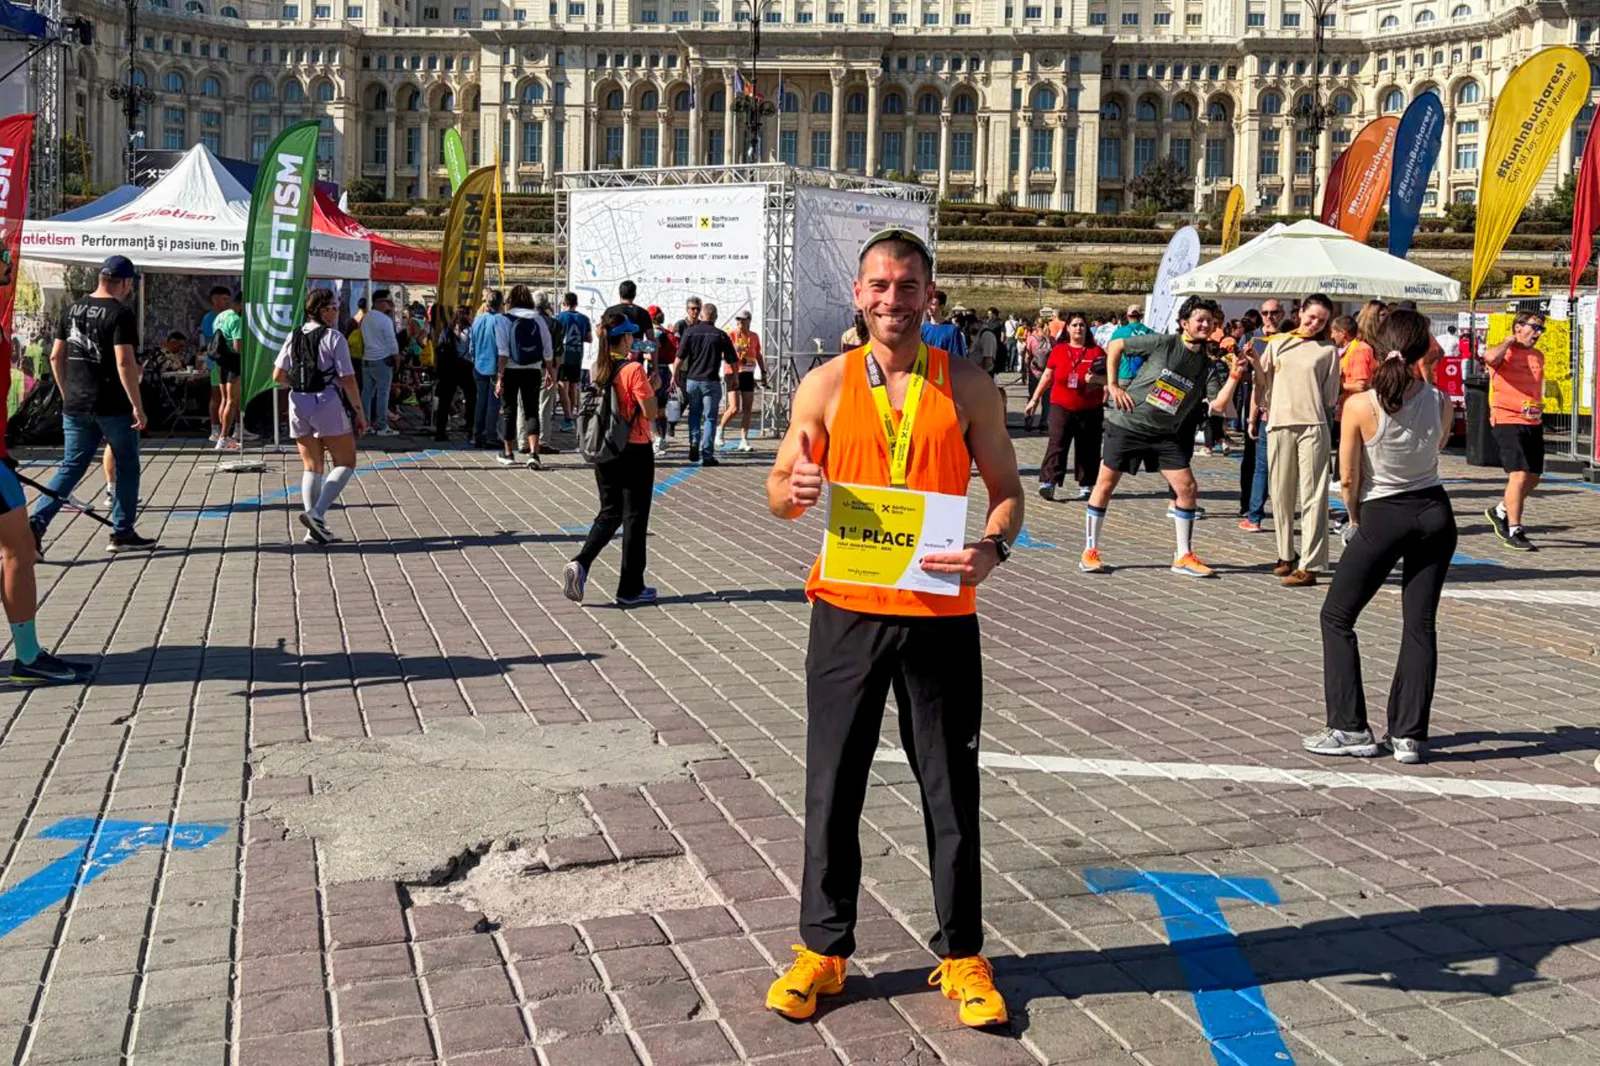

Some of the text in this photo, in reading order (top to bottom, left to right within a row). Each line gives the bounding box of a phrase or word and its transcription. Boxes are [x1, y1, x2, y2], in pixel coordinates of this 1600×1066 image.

[1397, 105, 1433, 198] #RunInBucharest
[1496, 62, 1567, 178] #RunInBucharest
[1507, 166, 1523, 183] City
[1534, 118, 1550, 135] City
[22, 232, 76, 246] atletism
[170, 238, 218, 252] pasiune.
[221, 239, 239, 251] Din
[267, 152, 304, 327] ATLETISM
[457, 192, 484, 306] TLETISM
[69, 304, 106, 319] NASA
[1524, 277, 1534, 289] 3
[862, 528, 915, 548] PLACE
